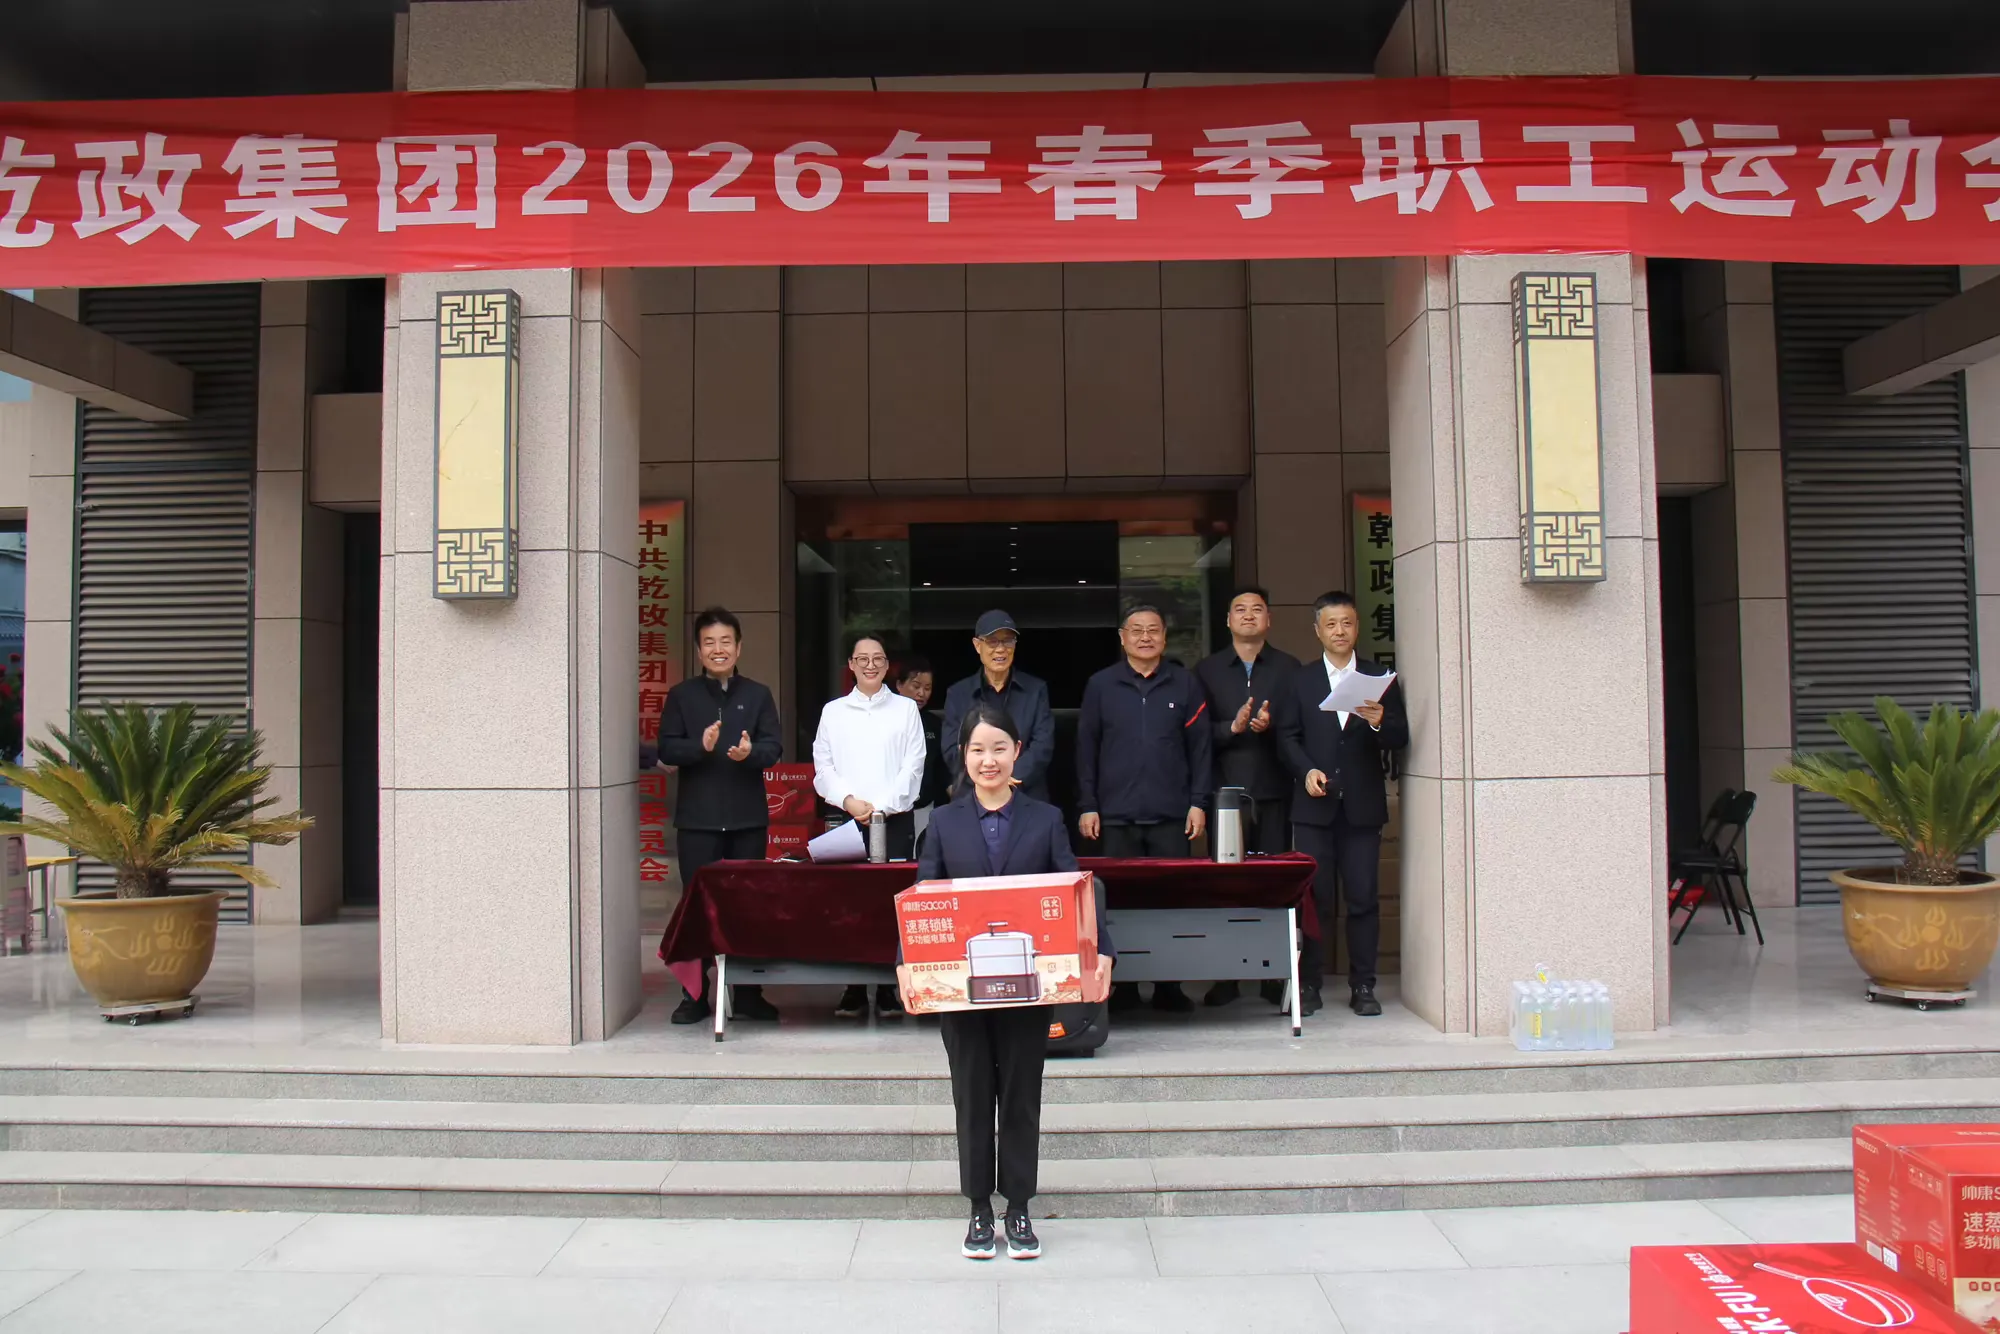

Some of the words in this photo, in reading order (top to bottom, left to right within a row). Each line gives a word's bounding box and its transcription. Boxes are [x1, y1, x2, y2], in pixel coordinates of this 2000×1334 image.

[639, 519, 670, 882] 中共乾政集团有限司委员会
[905, 917, 954, 934] 速蒸锁鲜
[1715, 1291, 1800, 1334] K-FU
